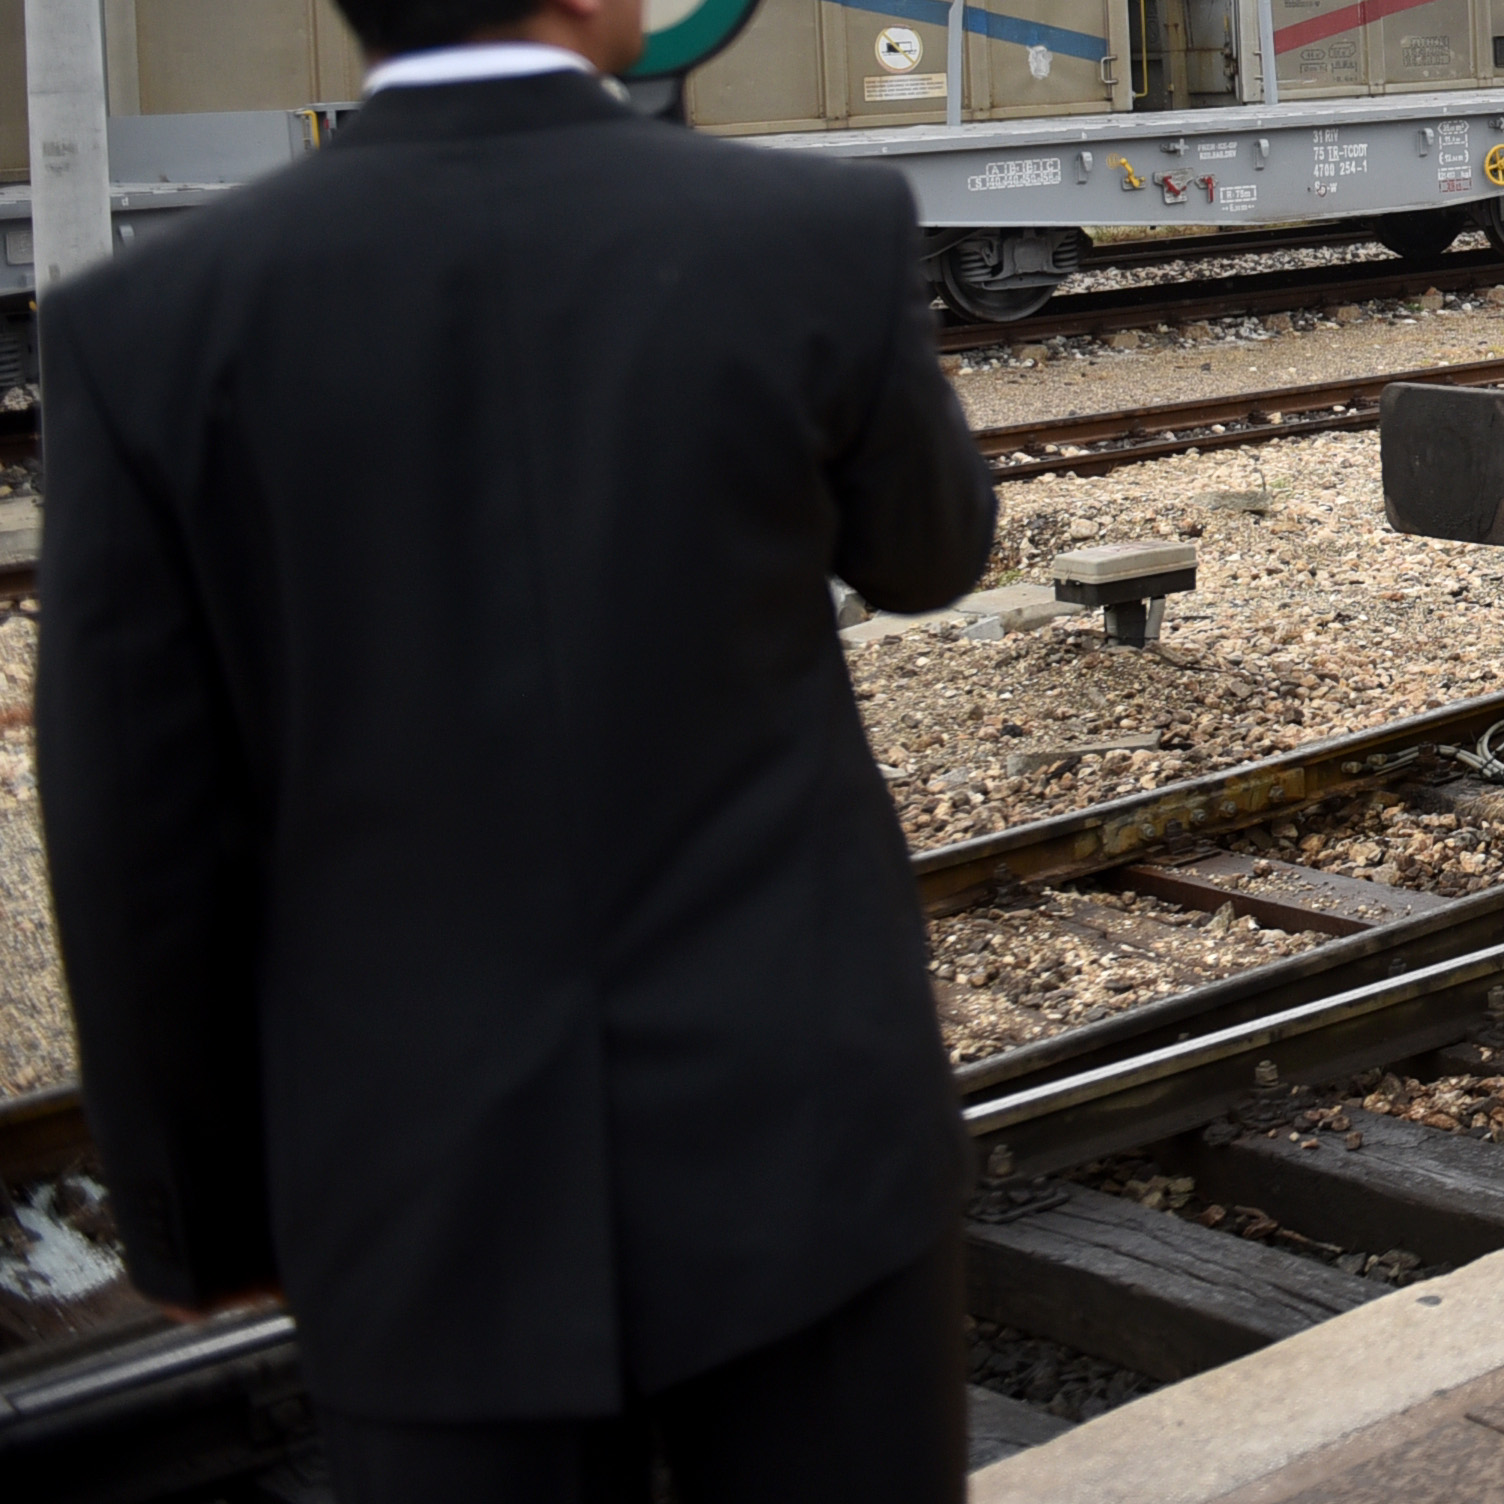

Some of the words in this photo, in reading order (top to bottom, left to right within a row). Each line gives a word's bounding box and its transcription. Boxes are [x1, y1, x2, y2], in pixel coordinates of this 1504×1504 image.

[1312, 129, 1324, 144] 31
[1313, 146, 1325, 161] 75
[1313, 163, 1335, 177] 4700
[1339, 159, 1368, 176] 254-1
